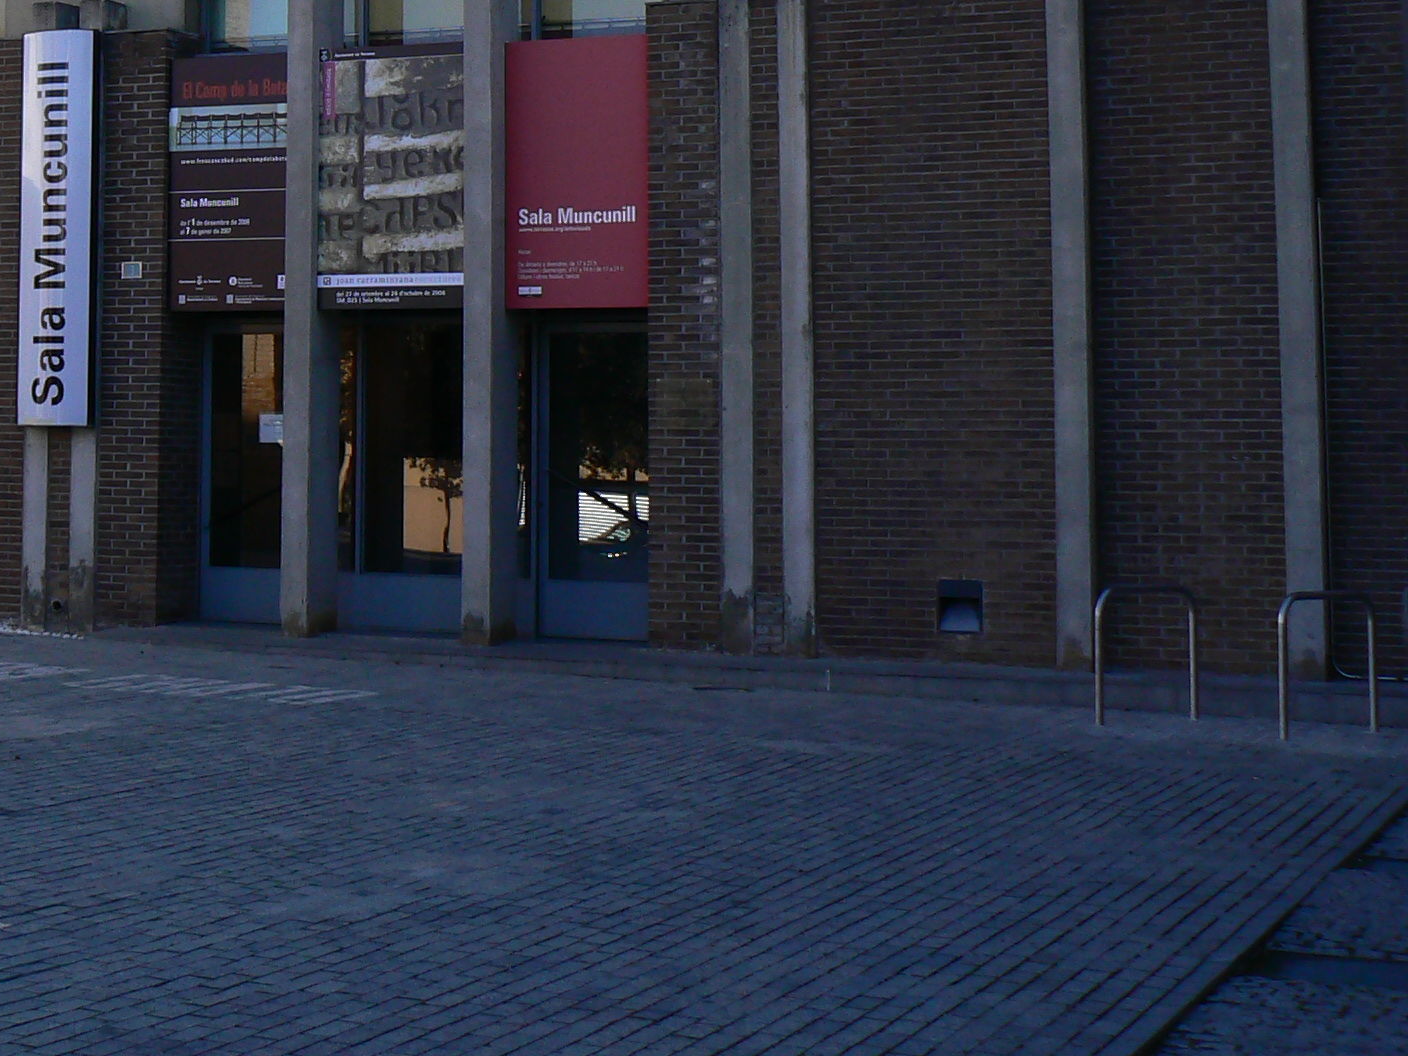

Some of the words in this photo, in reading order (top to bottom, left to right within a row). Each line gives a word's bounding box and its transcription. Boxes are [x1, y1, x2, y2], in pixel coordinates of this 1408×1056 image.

[231, 79, 246, 97] de
[34, 61, 69, 290] Muncunill
[180, 198, 198, 208] Sala
[518, 208, 552, 225] Sala
[557, 205, 636, 224] Muncunill
[31, 306, 66, 406] Sala
